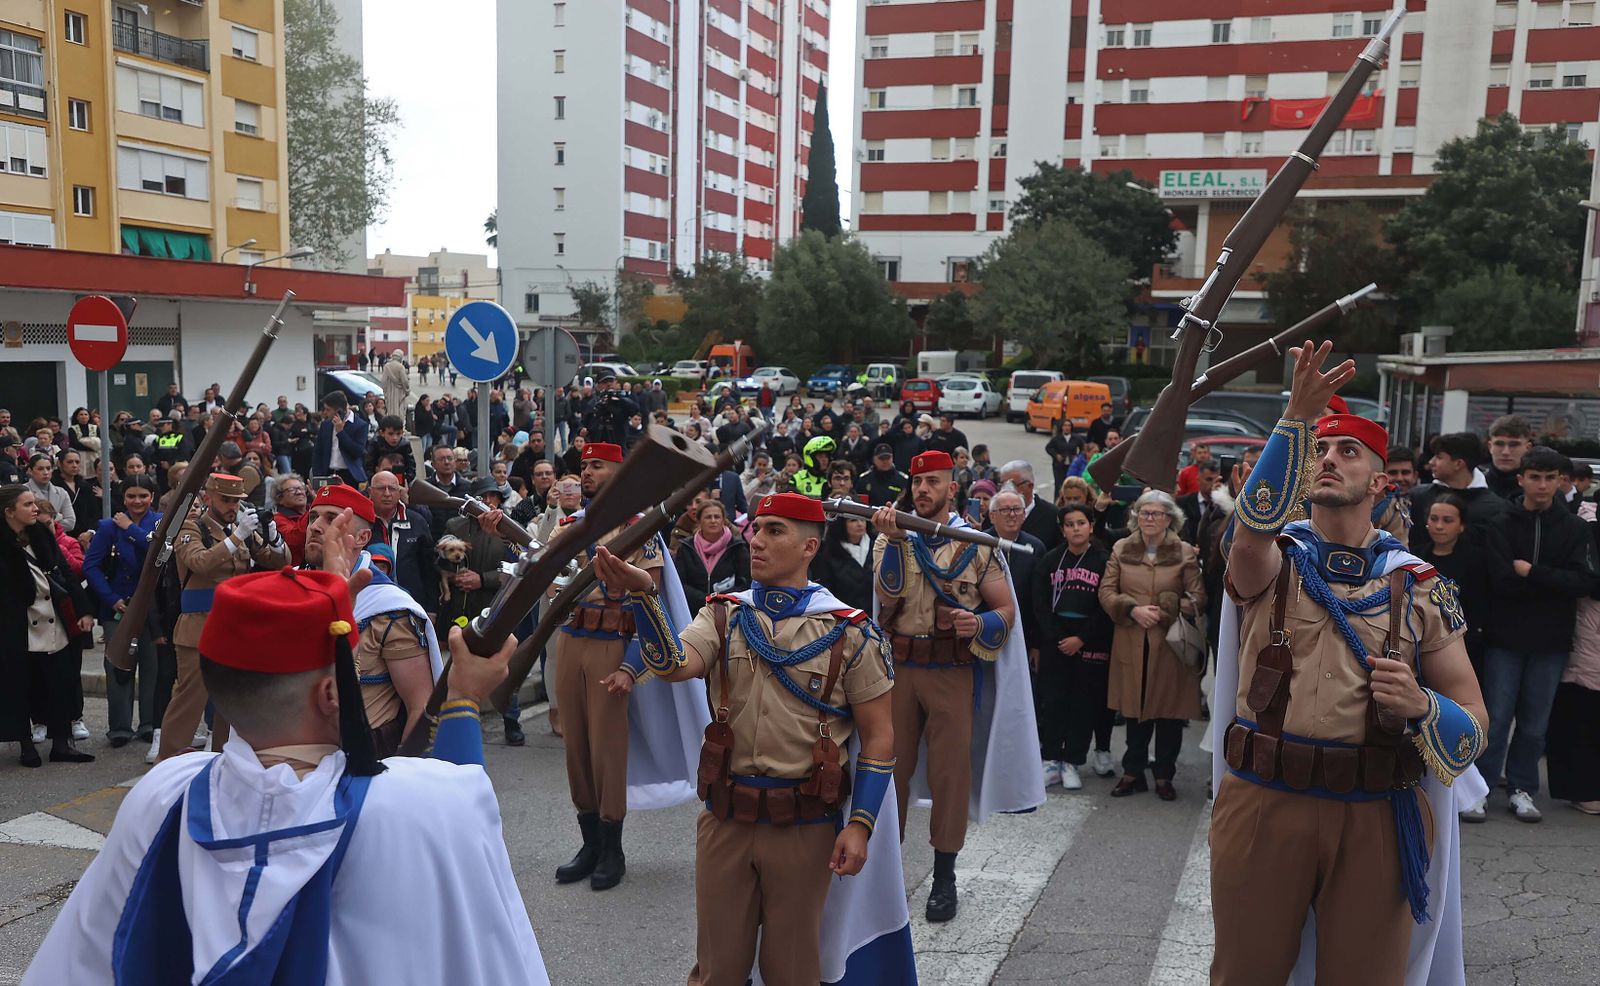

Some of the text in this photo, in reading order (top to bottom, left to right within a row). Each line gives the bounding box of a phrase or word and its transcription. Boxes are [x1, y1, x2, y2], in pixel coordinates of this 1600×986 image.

[1073, 393, 1105, 401] algesa
[1050, 567, 1100, 586] LOS ANGELES
